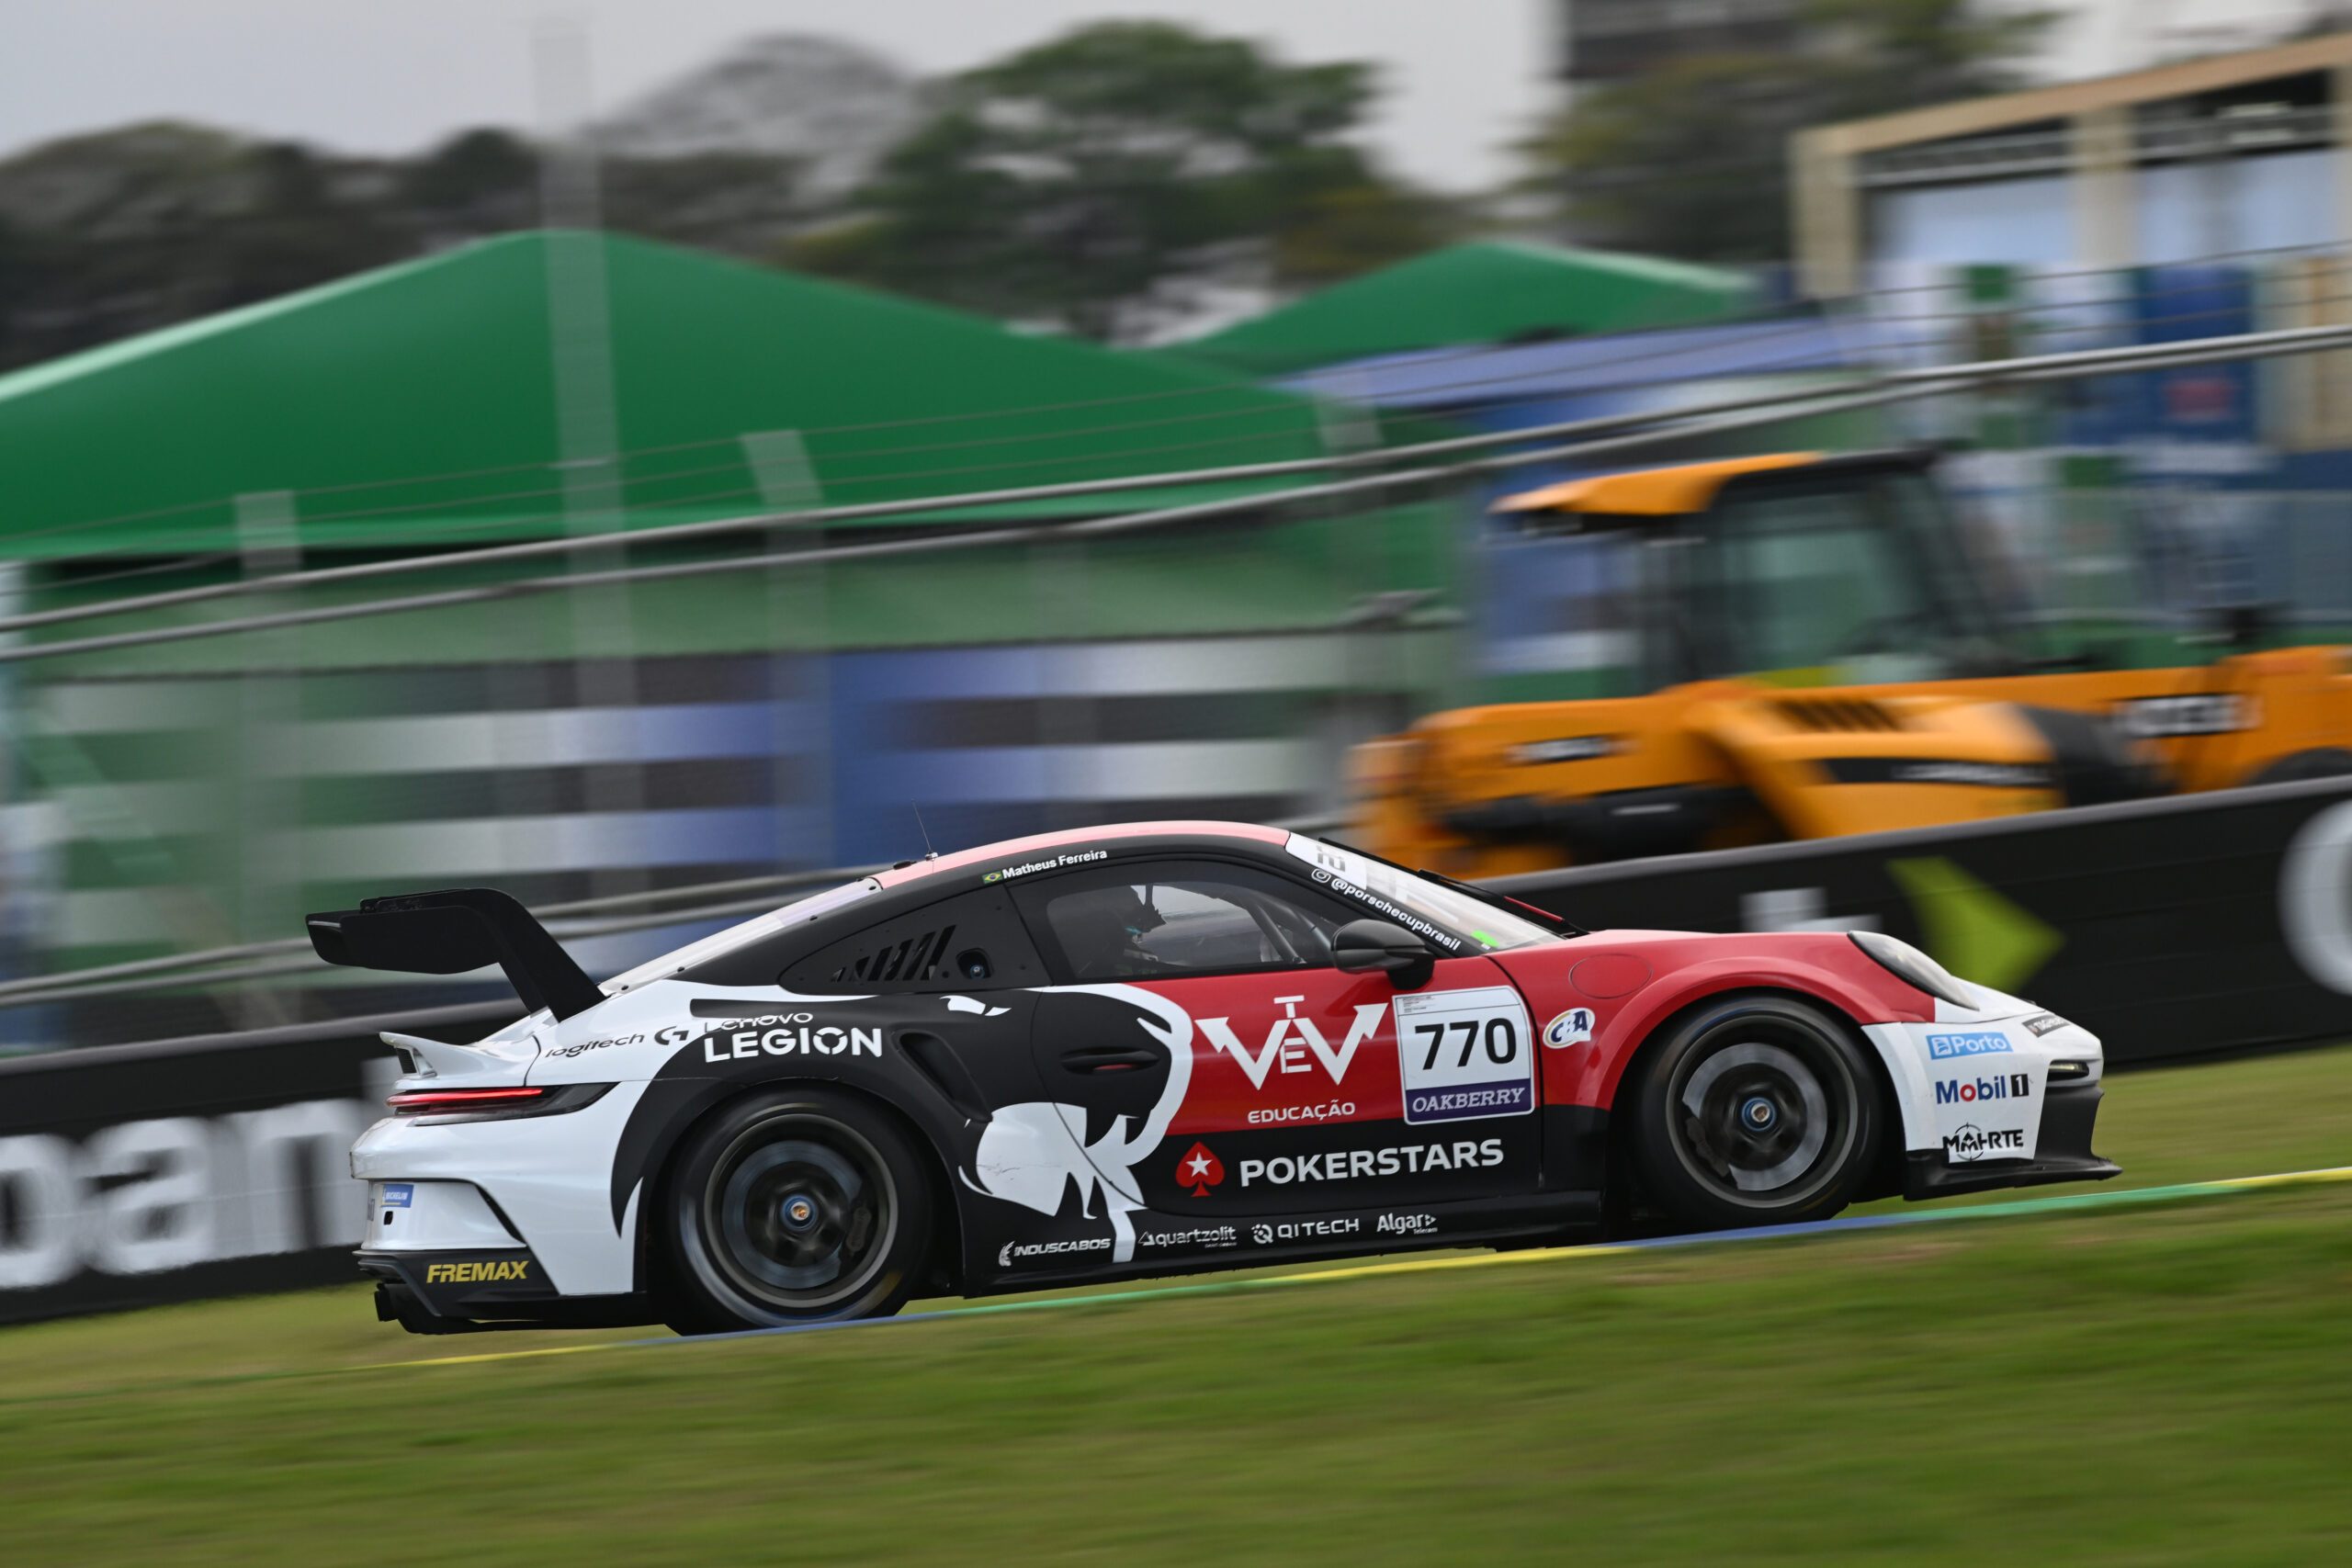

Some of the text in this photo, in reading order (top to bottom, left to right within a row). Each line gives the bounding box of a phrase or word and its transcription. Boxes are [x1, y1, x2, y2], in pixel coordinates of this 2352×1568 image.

[1001, 851, 1108, 879] Matheus Ferreira
[1330, 877, 1463, 952] @porschecupbrasil
[704, 1012, 814, 1033] Lenovo
[545, 1033, 645, 1058] logitech
[704, 1026, 883, 1064] LEGION
[1415, 1018, 1517, 1071] 770
[1951, 1035, 2008, 1054] Porto
[1412, 1087, 1526, 1113] OAKBERRY
[1935, 1076, 2007, 1105] Mobil
[1247, 1099, 1356, 1124] EDUCAÇÃO
[1240, 1138, 1505, 1188] POKERSTARS
[1156, 1225, 1238, 1248] quartzolit
[1376, 1213, 1424, 1235] Algar
[1013, 1237, 1112, 1258] INDUSCABOS
[426, 1260, 530, 1284] FREMAX
